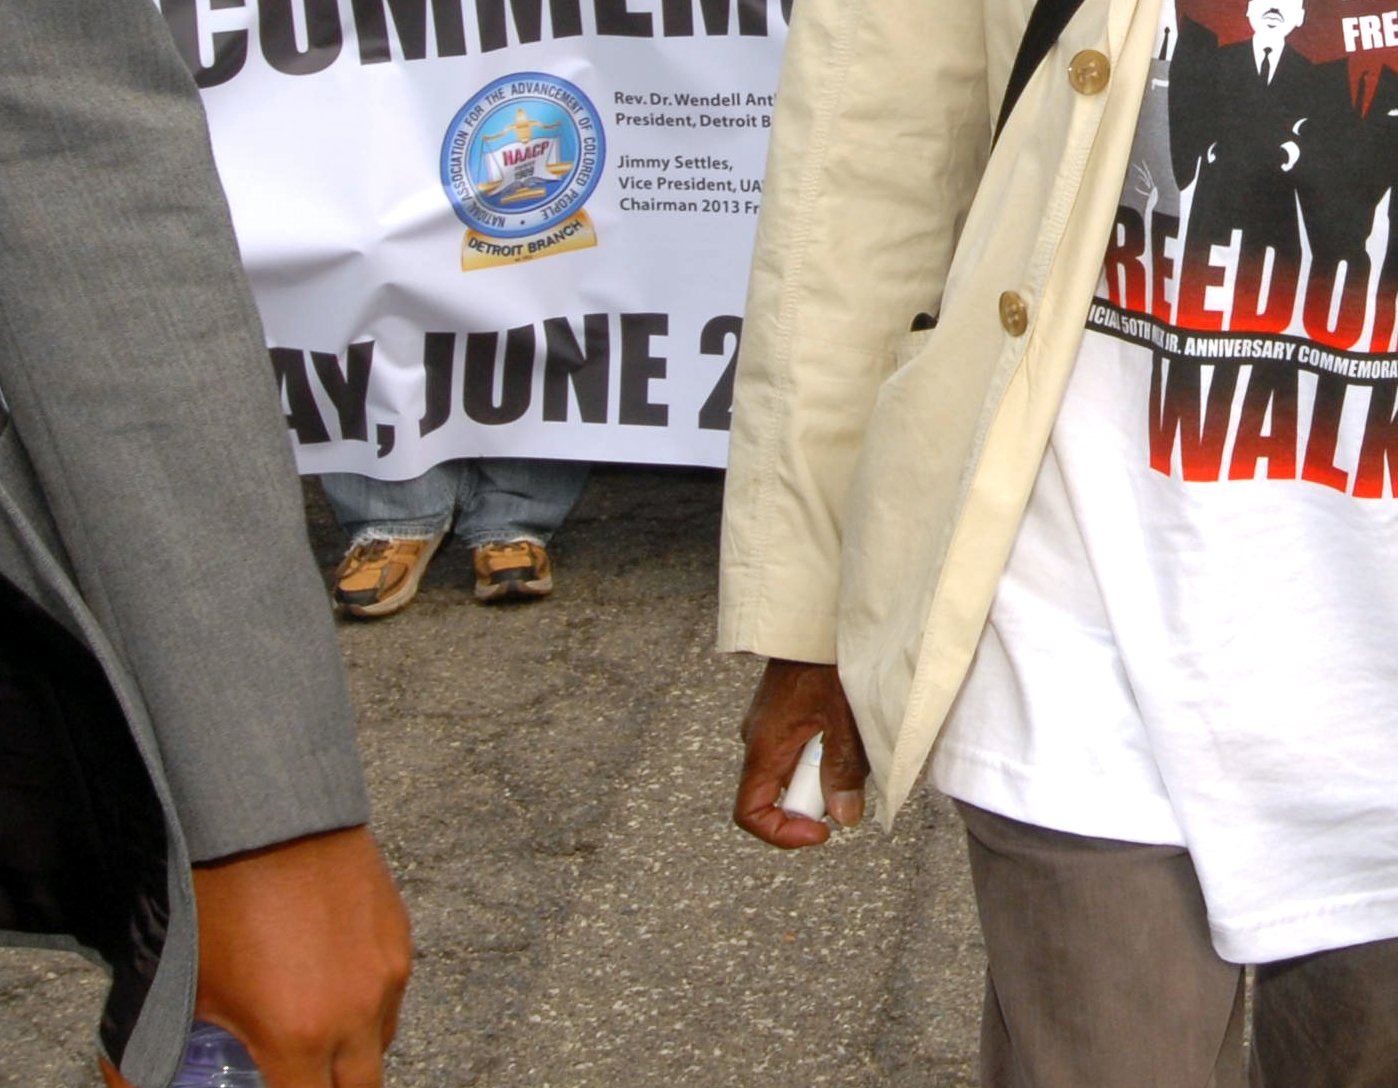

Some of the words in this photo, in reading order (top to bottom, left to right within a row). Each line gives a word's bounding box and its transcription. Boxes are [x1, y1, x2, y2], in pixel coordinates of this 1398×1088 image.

[484, 86, 506, 106] THE
[511, 81, 584, 115] ADVANCEMENT
[614, 90, 648, 106] Rev.
[649, 92, 673, 107] Dr.
[674, 93, 741, 107] Wendell
[745, 93, 777, 107] Ant
[463, 104, 485, 128] FOR
[578, 116, 594, 131] OF
[615, 112, 697, 129] President,
[699, 114, 758, 128] Detroit
[450, 129, 473, 202] ASSOCIATION
[502, 140, 551, 168] NAACP
[575, 135, 597, 188] COLORED
[616, 155, 671, 172] Jimmy
[674, 155, 734, 172] Settles,
[618, 176, 653, 190] Vice
[656, 177, 737, 193] President,
[740, 179, 764, 193] UA
[541, 187, 580, 221] PEOPLE
[619, 197, 698, 212] Chairman
[701, 199, 740, 213] 2013
[467, 236, 524, 257] DETROIT
[527, 219, 585, 254] BRANCH
[1120, 315, 1152, 342] 50TH
[1164, 331, 1183, 355] JR.
[1184, 337, 1296, 362] ANNIVERSARY
[418, 312, 669, 439] JUNE
